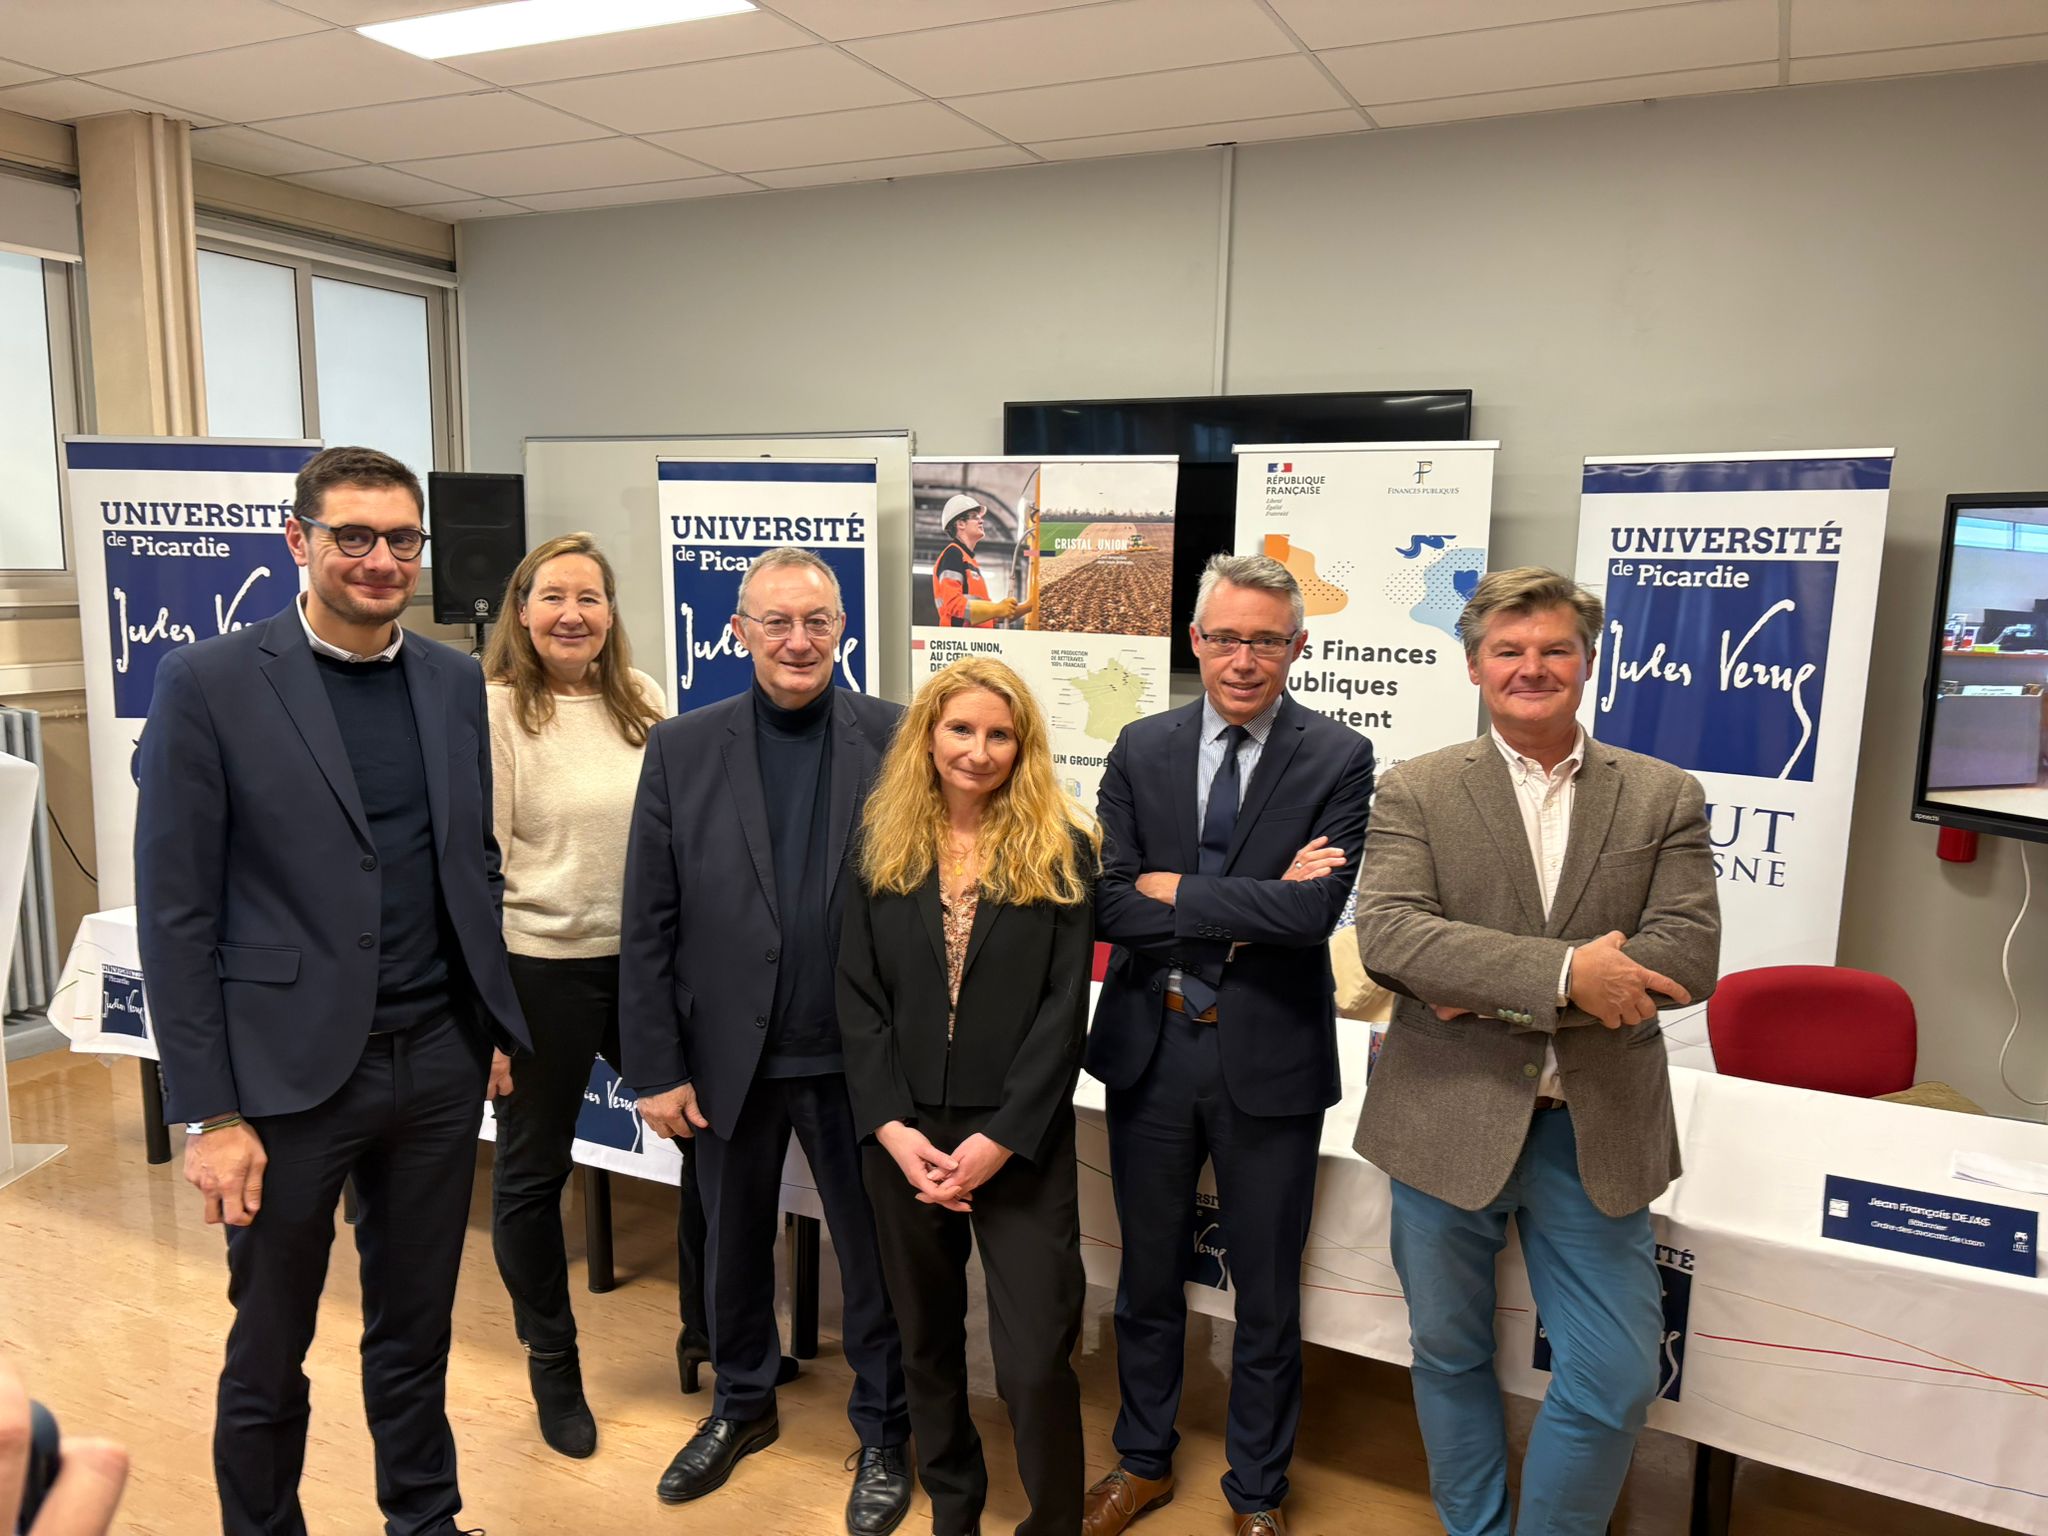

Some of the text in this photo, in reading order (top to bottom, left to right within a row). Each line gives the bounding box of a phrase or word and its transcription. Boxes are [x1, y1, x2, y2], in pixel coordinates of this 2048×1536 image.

[1266, 475, 1326, 485] RÉPUBLIQUE
[1266, 486, 1321, 496] FRANÇAISE
[100, 499, 294, 528] UNIVERSITÉ
[671, 512, 865, 542] UNIVERSITÉ
[1610, 520, 1843, 555] UNIVERSITÉ
[106, 532, 231, 558] de Picardie
[1054, 537, 1128, 551] CRISTAL UNION
[675, 546, 754, 572] de Pica
[1611, 560, 1750, 588] de Picardie
[681, 602, 749, 690] Jule
[930, 640, 1003, 655] CRISTAL UNION,
[930, 652, 943, 661] AU
[1322, 639, 1437, 665] Finances
[1288, 671, 1398, 700] ubliques
[1601, 598, 1816, 780] Jules Verne
[1053, 754, 1067, 764] UN
[1705, 803, 1795, 854] UT
[1713, 852, 1786, 887] SNE
[1868, 1198, 1899, 1210] Jean
[1899, 1203, 1952, 1219] François
